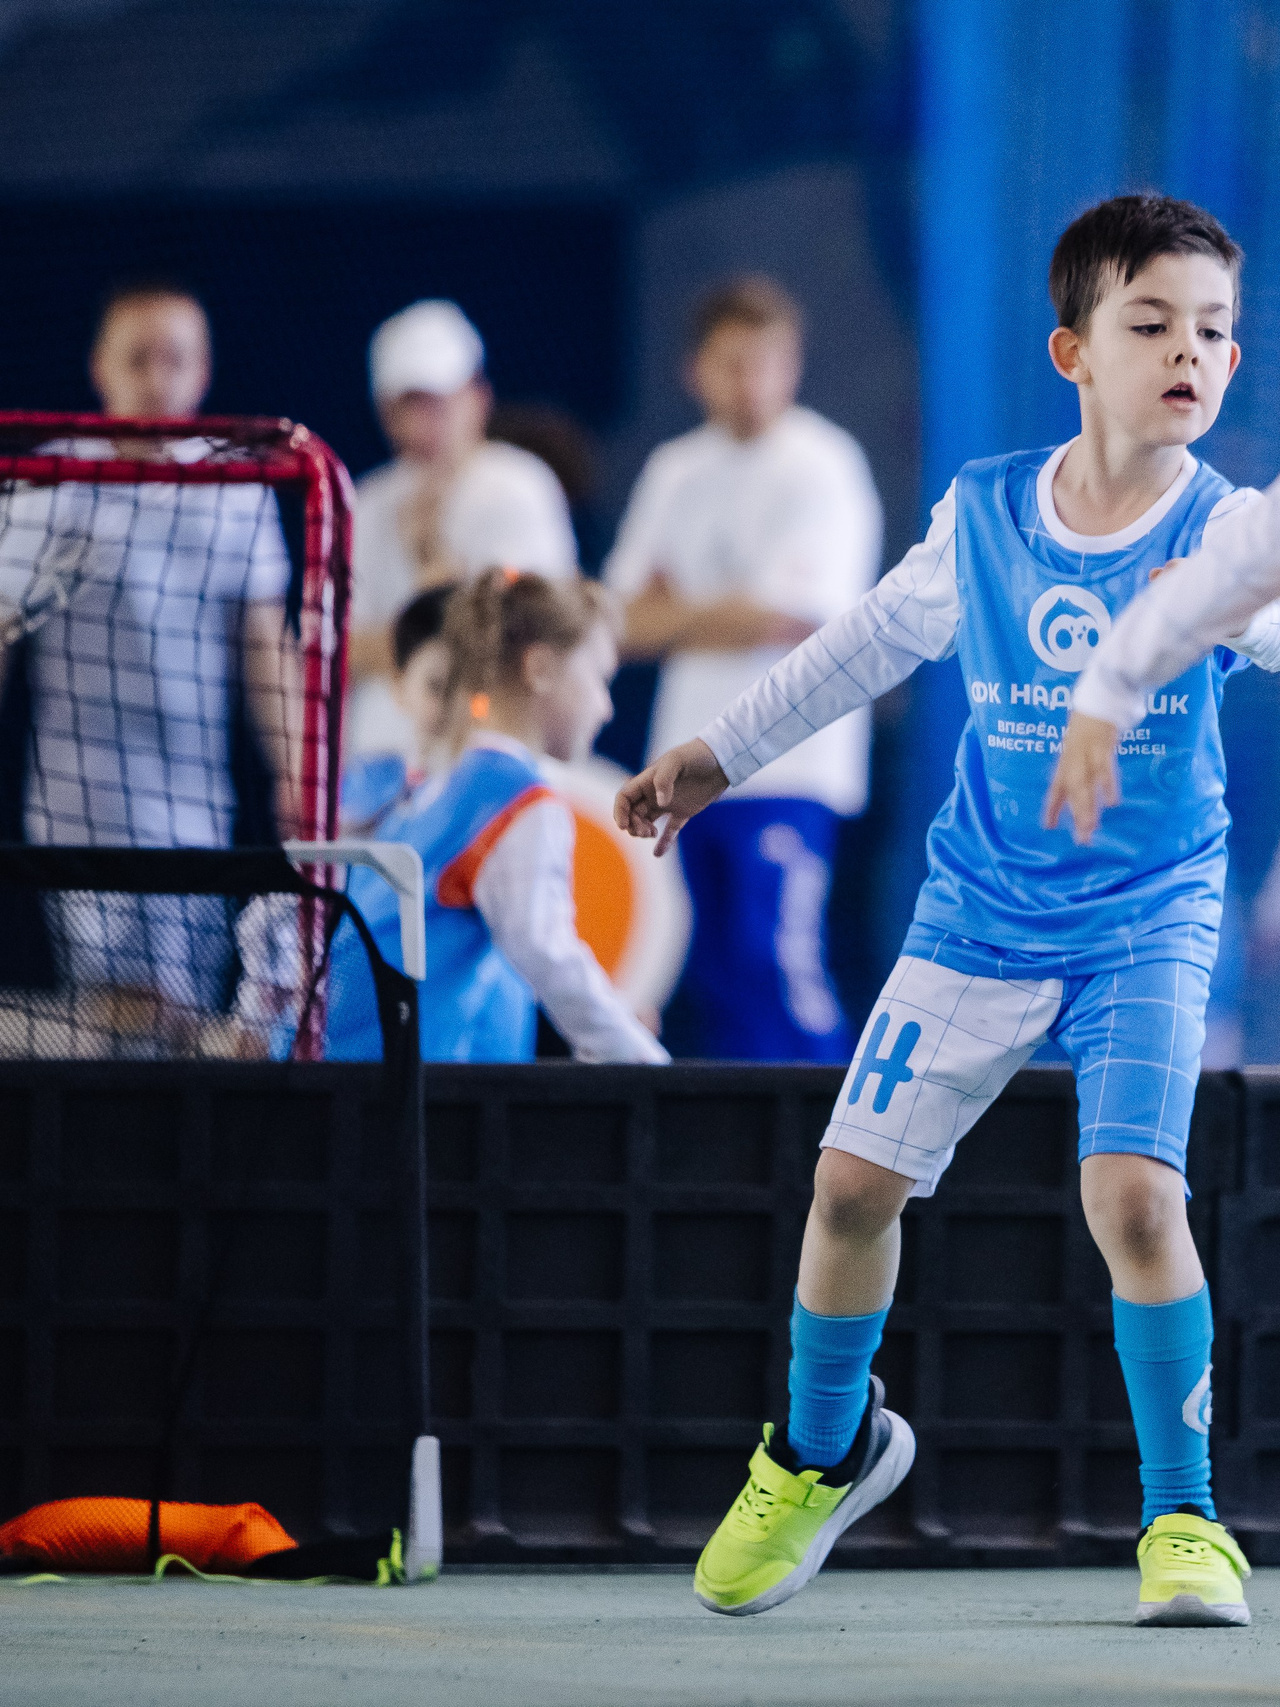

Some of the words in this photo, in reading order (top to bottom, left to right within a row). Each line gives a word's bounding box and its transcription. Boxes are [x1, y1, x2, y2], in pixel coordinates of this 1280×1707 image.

[971, 681, 1001, 704] ФК
[997, 720, 1059, 739] ВПЕРЁД
[987, 735, 1045, 753] ВМЕСТЕ
